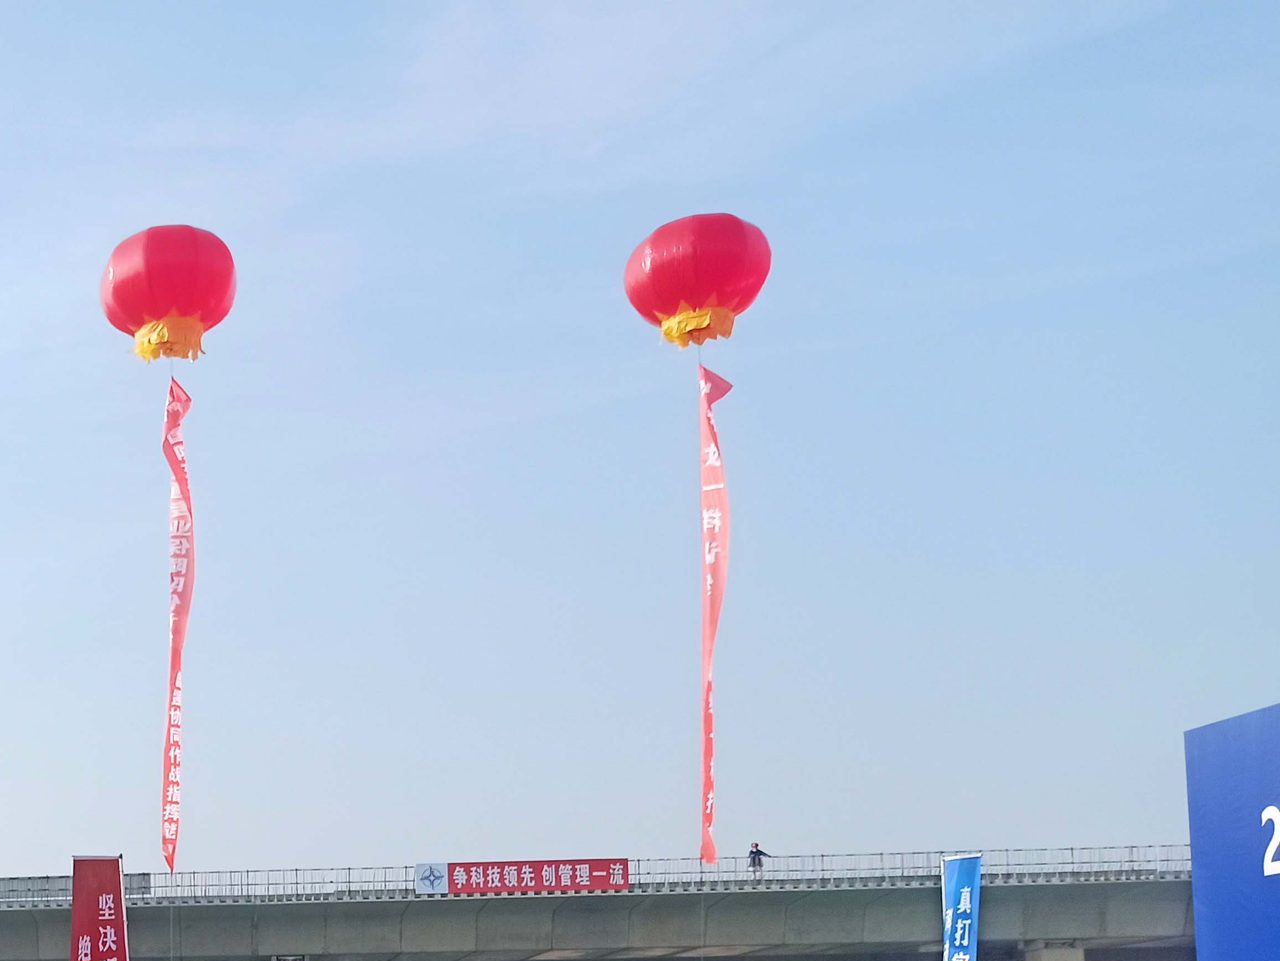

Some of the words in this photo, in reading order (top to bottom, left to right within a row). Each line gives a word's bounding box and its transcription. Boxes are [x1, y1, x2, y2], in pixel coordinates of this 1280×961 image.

[1261, 805, 1280, 876] 2
[453, 865, 535, 888] 争科技领先
[542, 863, 625, 887] 创管理一流
